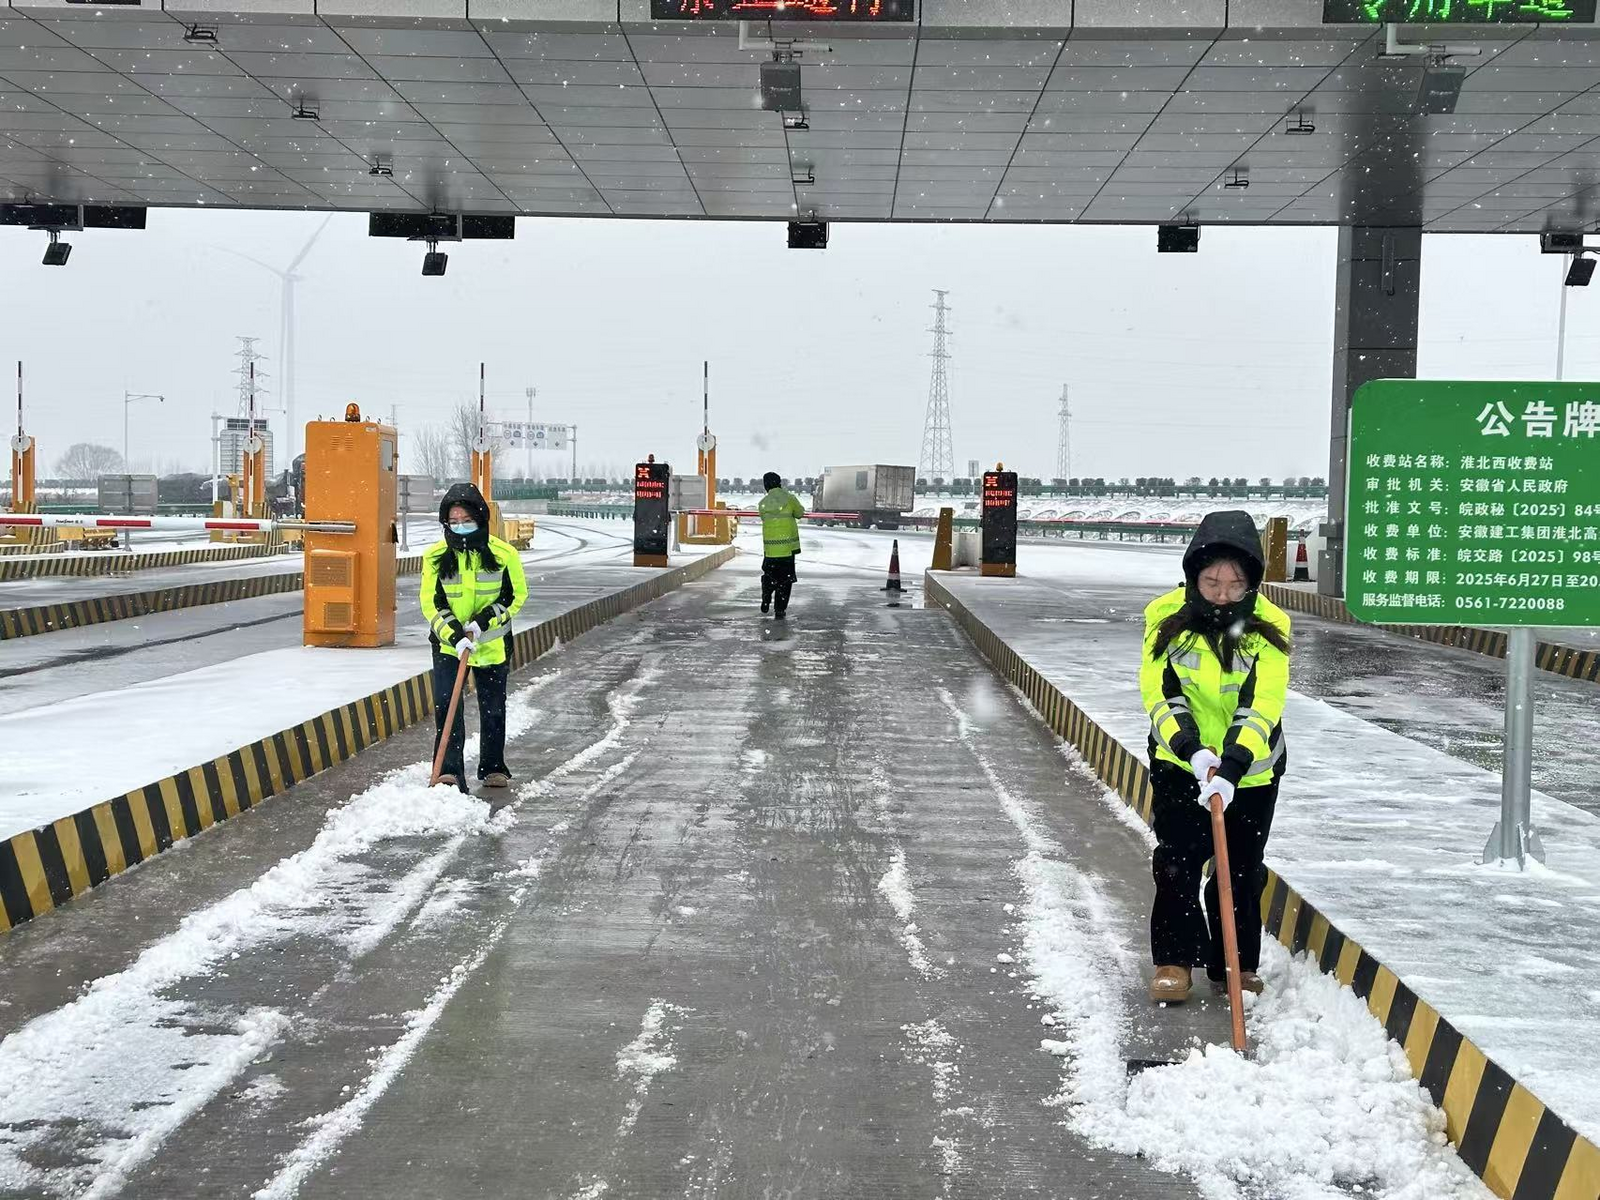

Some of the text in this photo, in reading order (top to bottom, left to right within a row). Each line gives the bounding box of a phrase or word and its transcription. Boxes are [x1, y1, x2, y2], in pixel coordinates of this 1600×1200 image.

[1475, 400, 1600, 438] 公告牌
[1460, 455, 1554, 471] 淮北西收费站
[1460, 478, 1569, 494] 安徽省人民政府
[1458, 524, 1600, 540] 安徽建工集团淮北高
[1456, 572, 1600, 588] 2025年6月27日至20
[1455, 596, 1565, 610] 0561-7220088
